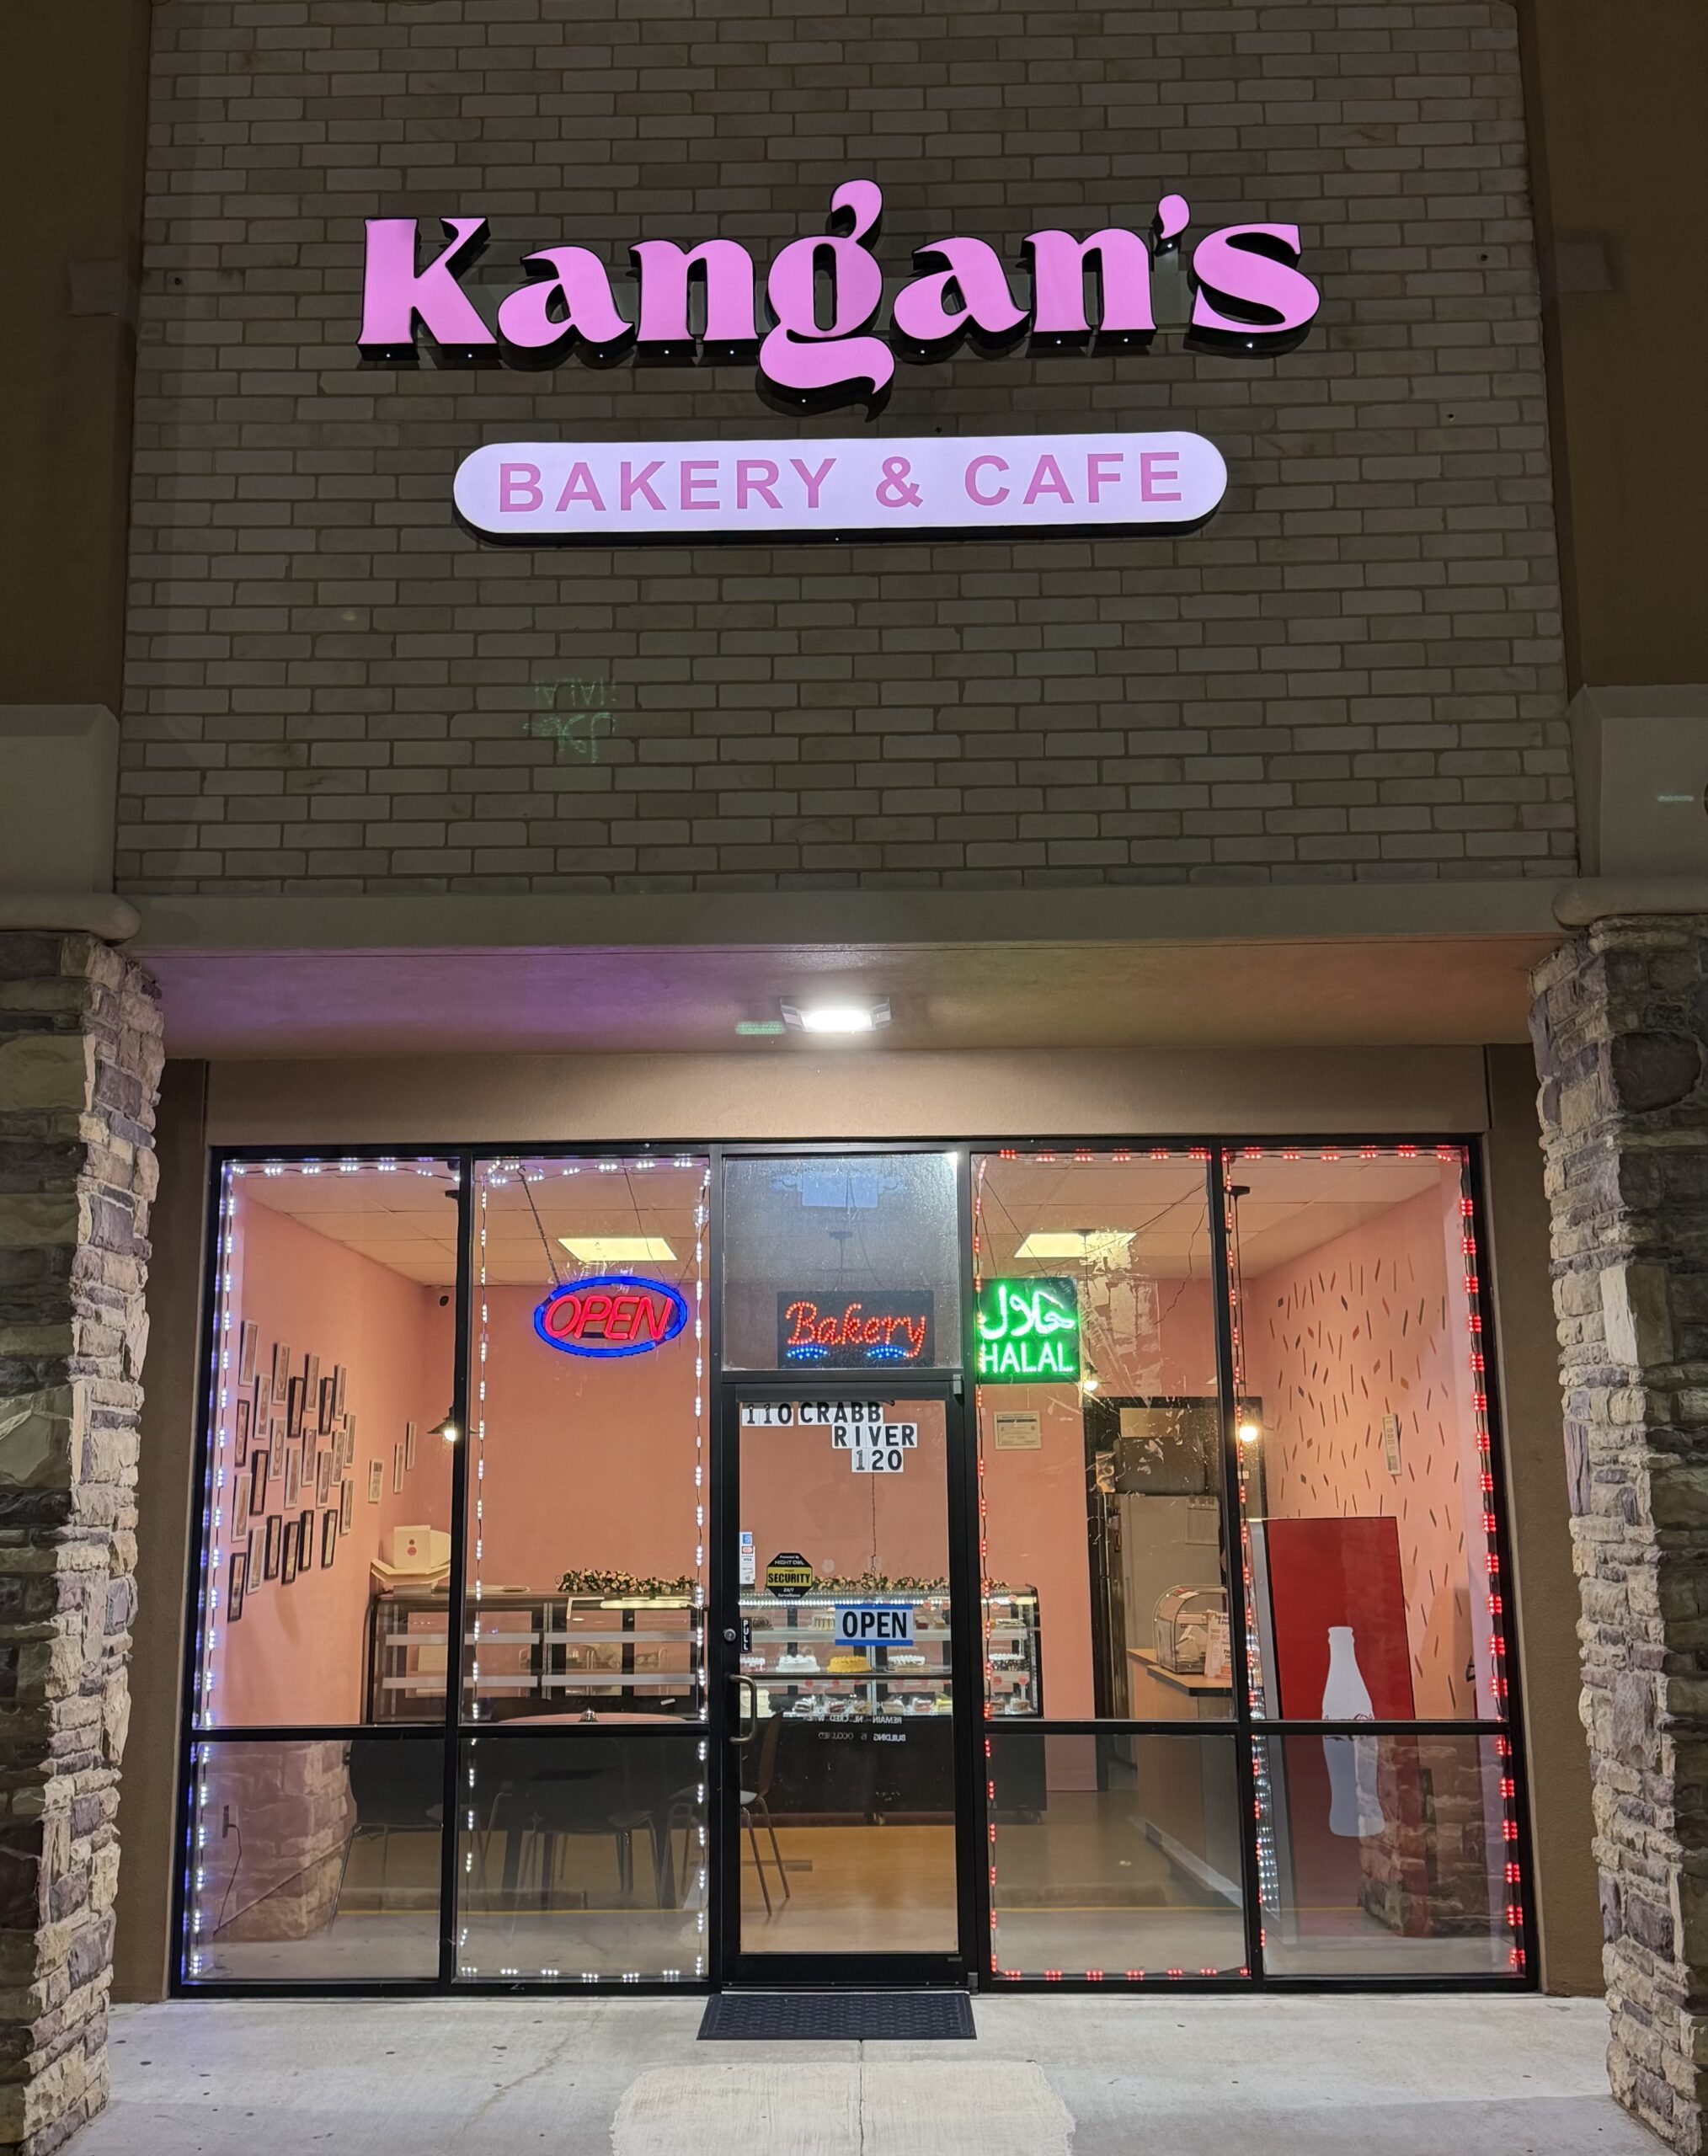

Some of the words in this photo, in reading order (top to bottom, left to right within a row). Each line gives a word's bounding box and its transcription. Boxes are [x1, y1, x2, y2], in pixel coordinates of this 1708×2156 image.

[356, 178, 1321, 394] Kangan's
[499, 457, 837, 513] BAKERY
[875, 456, 924, 508] &
[963, 451, 1182, 506] CAFE
[544, 1294, 674, 1341] OPEN
[979, 1284, 1076, 1341] حلال
[785, 1301, 926, 1358] Bakery
[979, 1342, 1075, 1374] HALAL
[746, 1403, 793, 1425] 110
[799, 1402, 882, 1424] CRABB
[834, 1425, 915, 1448] RIVER
[856, 1449, 903, 1471] 120
[768, 1572, 811, 1584] SECURITY
[842, 1610, 908, 1639] OPEN
